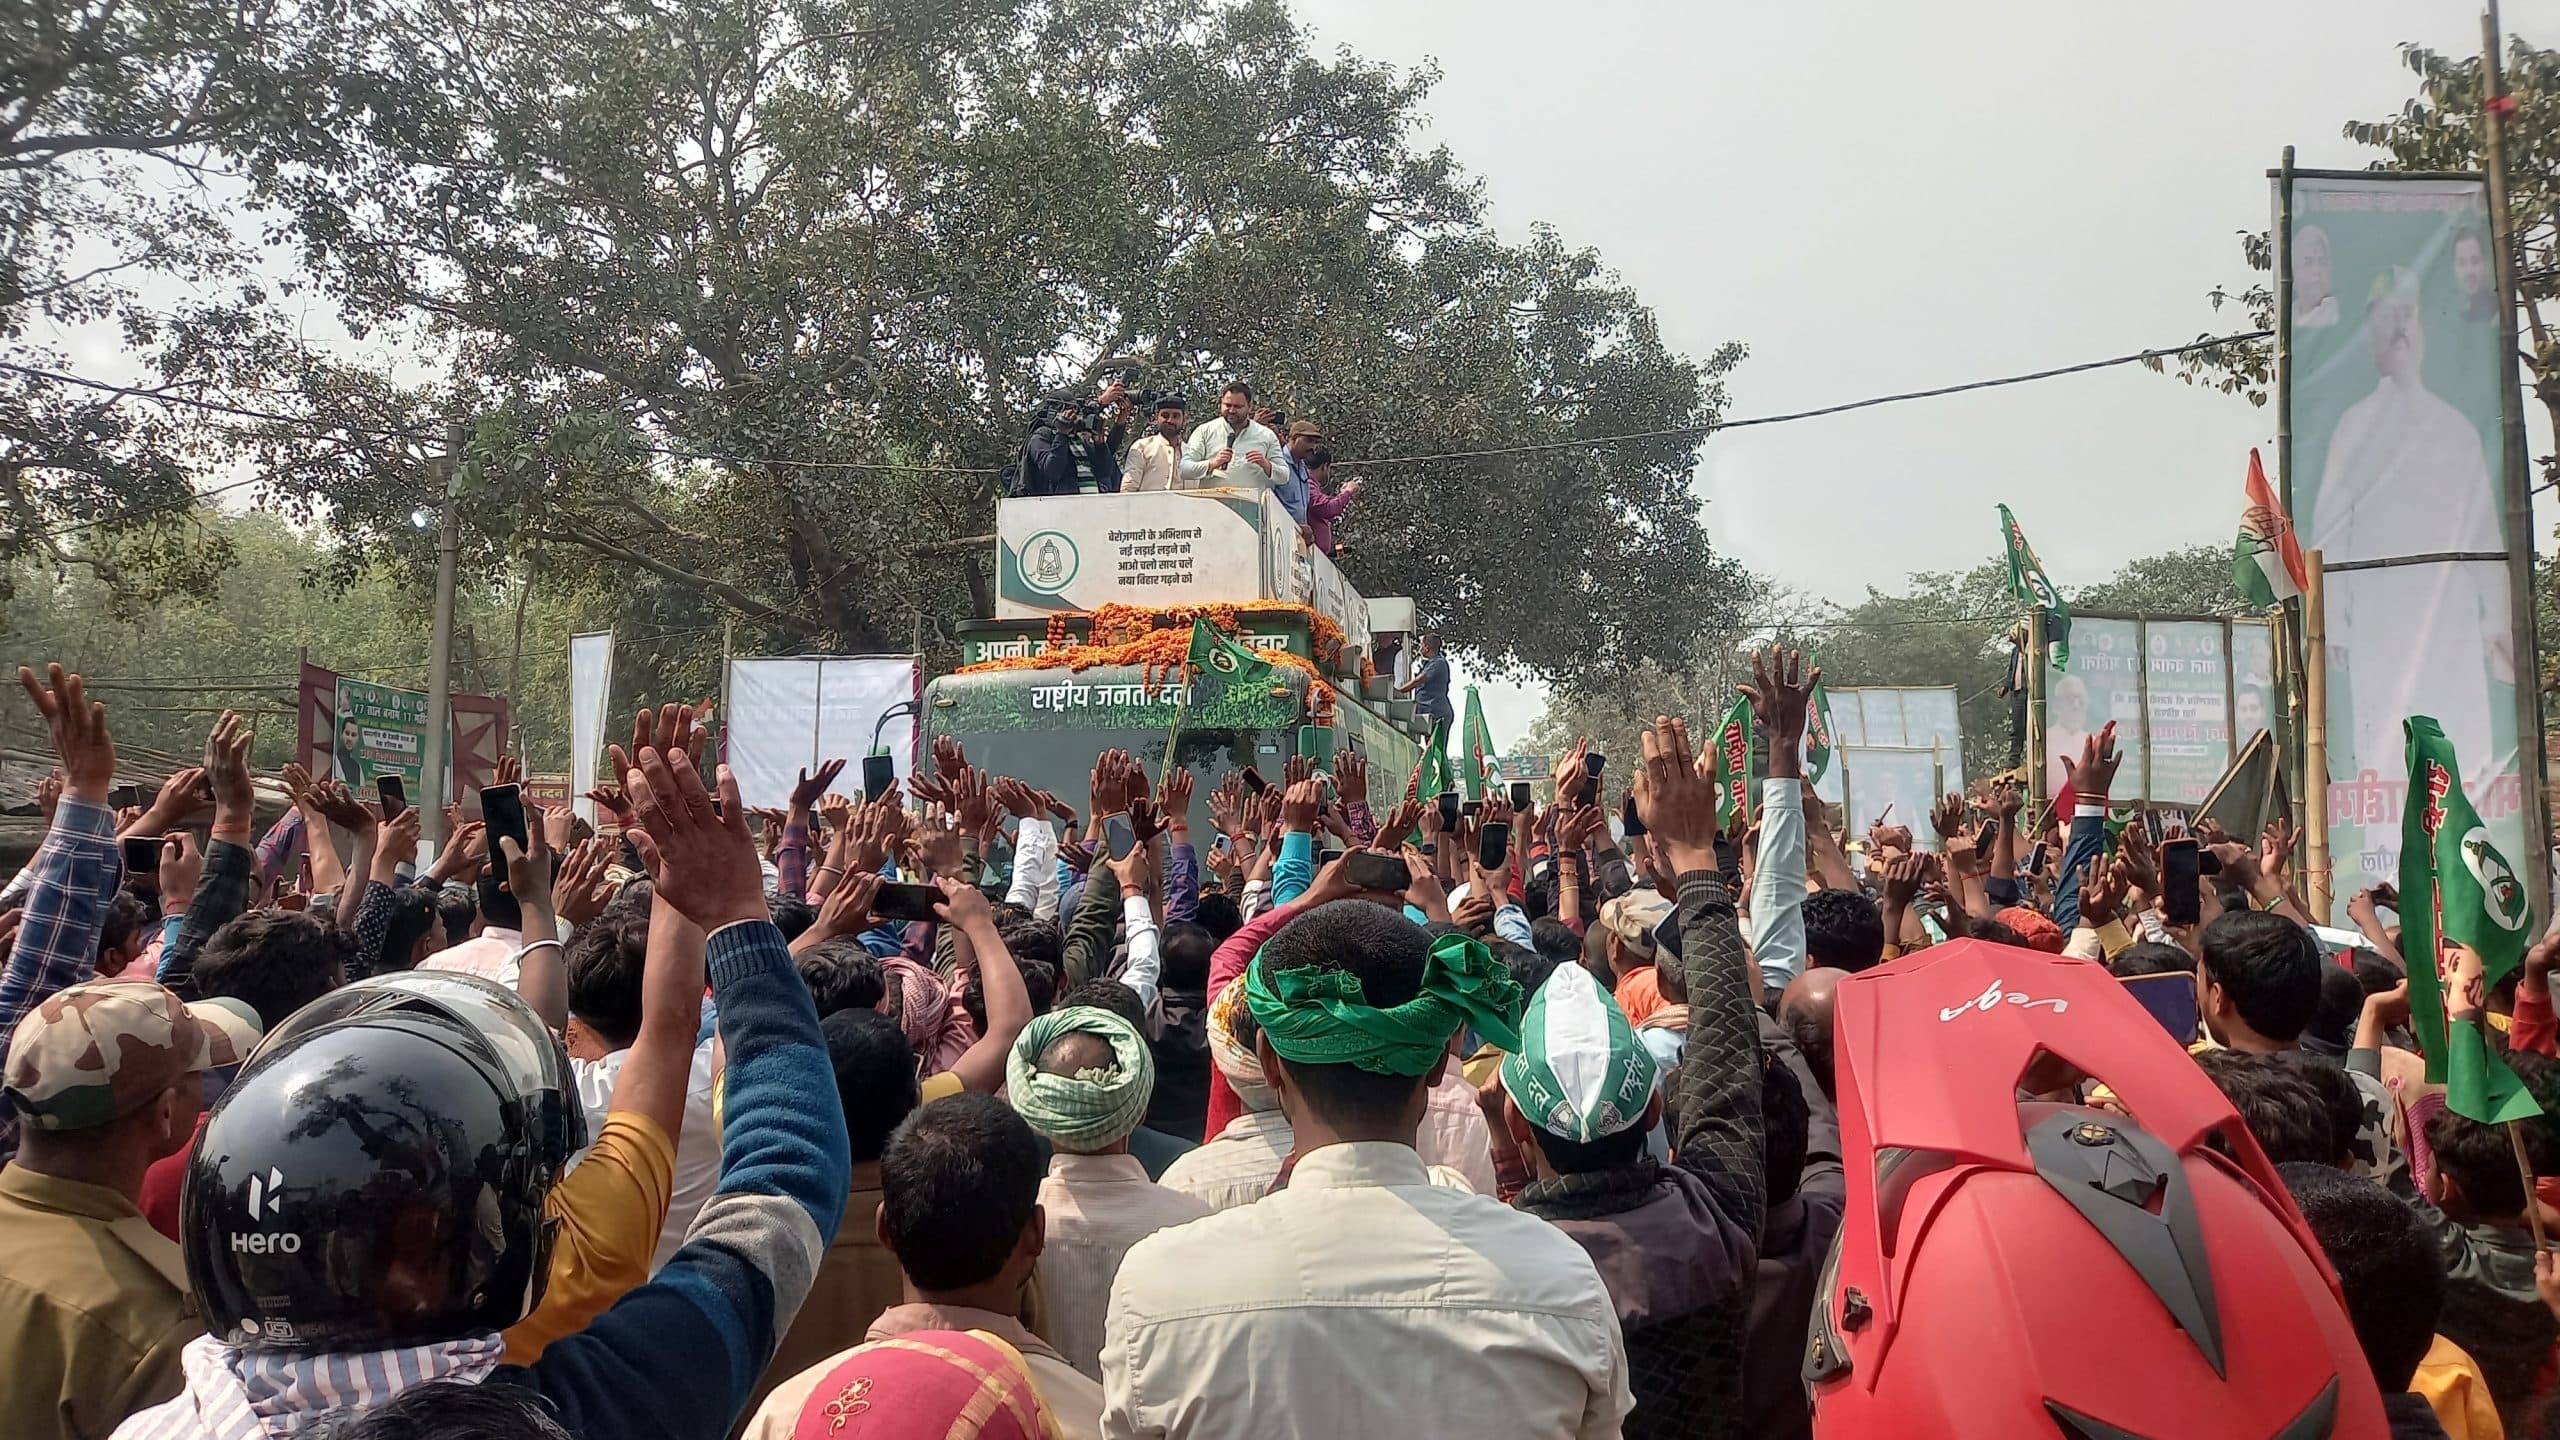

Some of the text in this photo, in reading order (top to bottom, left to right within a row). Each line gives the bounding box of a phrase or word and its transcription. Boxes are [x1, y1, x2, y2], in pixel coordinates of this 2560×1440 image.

[1147, 529, 1157, 540] के
[1158, 527, 1192, 540] अभिशाप
[1193, 526, 1202, 539] से
[1119, 542, 1191, 558] नई लड़ाई लड़ने को
[1118, 557, 1194, 571] आओ चलो साथ चलें
[1118, 571, 1192, 587] नया बिहार गढ़ने को
[975, 634, 1031, 662] अपनी
[1031, 678, 1090, 713] राष्ट्रीय
[1094, 683, 1152, 707] जनता
[1527, 1075, 1551, 1112] दल
[230, 1231, 301, 1254] Hero
